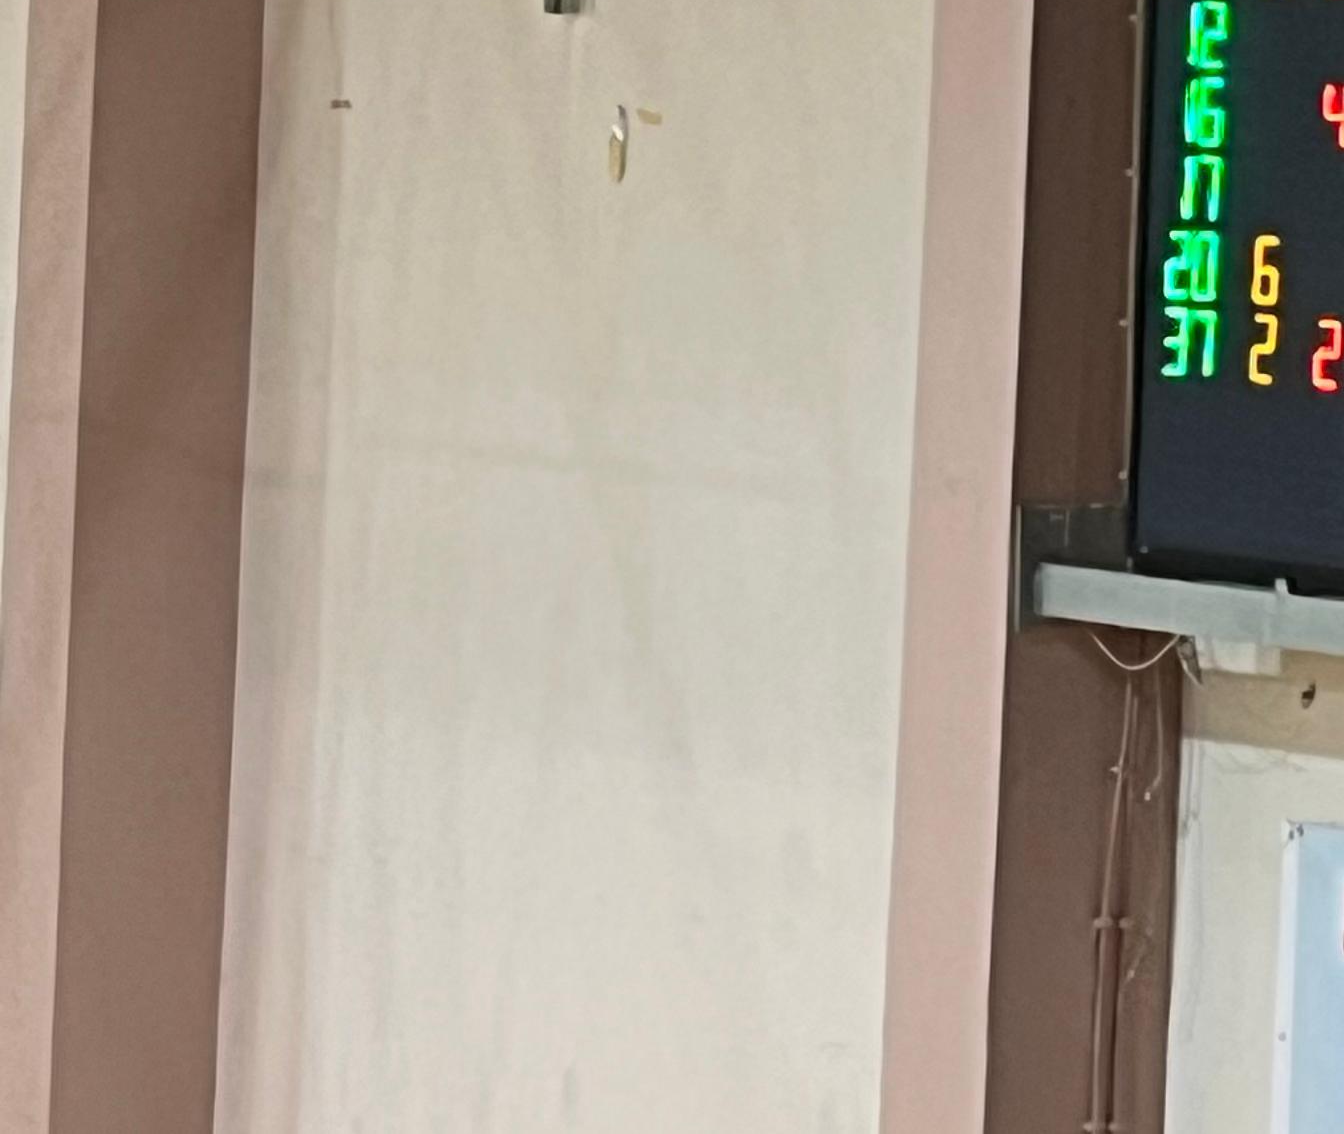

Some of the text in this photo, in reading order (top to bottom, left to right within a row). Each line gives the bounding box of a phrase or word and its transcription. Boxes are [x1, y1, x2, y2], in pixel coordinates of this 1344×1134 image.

[1180, 155, 1223, 221] 17
[1251, 235, 1280, 305] 6
[1161, 306, 1341, 390] 37 2 2
